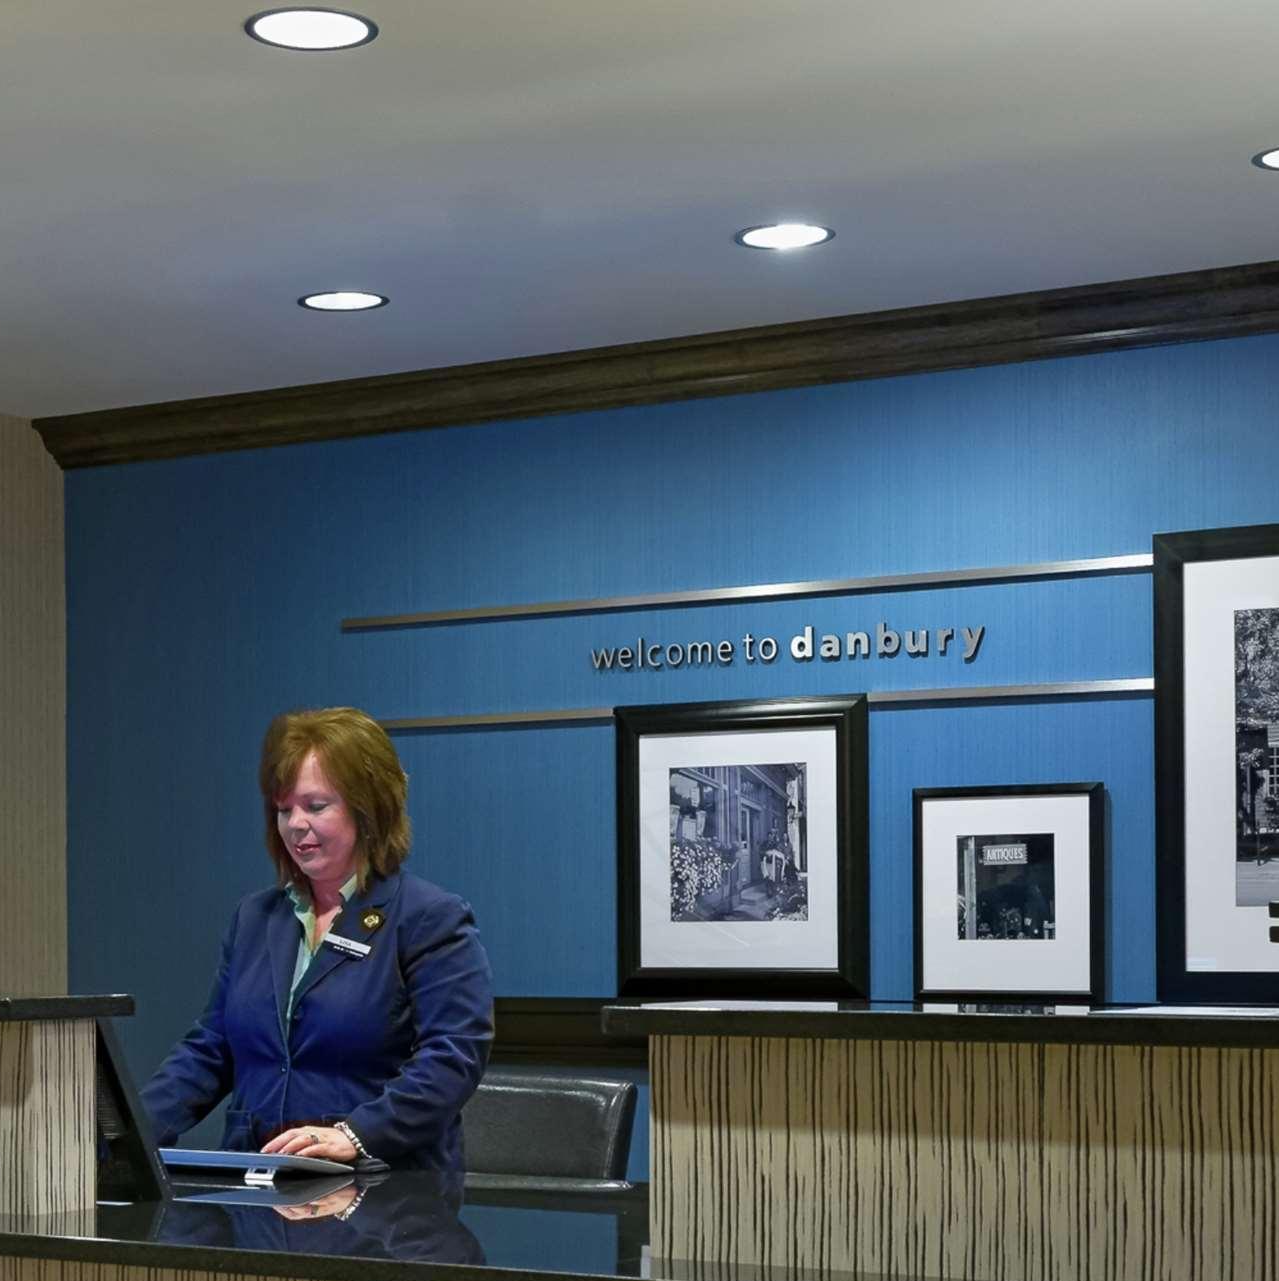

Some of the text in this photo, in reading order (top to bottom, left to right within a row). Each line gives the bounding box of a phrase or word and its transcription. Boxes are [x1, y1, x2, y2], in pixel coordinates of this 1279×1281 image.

[591, 621, 987, 670] welcome to danbury
[986, 847, 1025, 862] ANTIQUES
